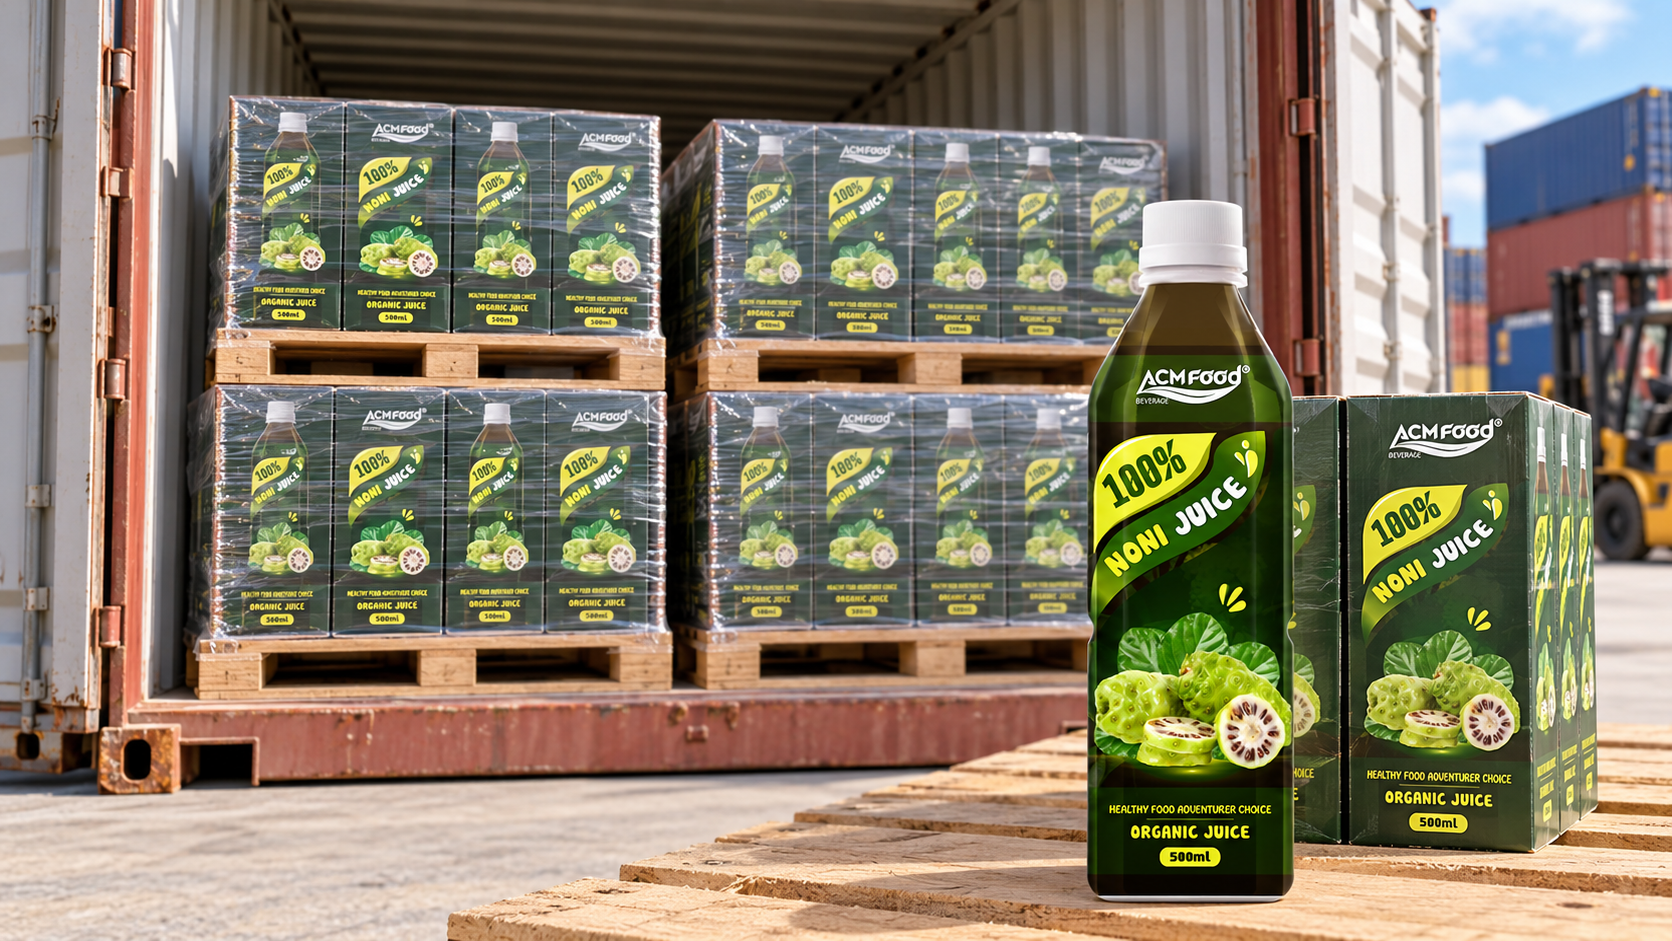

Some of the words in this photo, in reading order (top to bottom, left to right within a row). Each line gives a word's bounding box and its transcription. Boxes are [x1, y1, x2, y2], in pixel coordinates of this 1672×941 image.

[266, 165, 293, 185] 100%
[363, 160, 399, 186] 100%
[571, 168, 604, 193] 100%
[362, 191, 391, 214] NONI
[392, 173, 425, 197] JUICE
[481, 174, 505, 193] 100%
[833, 179, 864, 204] 100%
[570, 200, 597, 220] NONI
[599, 181, 627, 205] JUICE
[750, 185, 772, 205] 100%
[859, 192, 886, 216] JUICE
[261, 298, 293, 306] ORGANIC
[295, 298, 317, 307] JUICE
[366, 301, 401, 309] ORGANIC
[402, 301, 427, 310] JUICE
[608, 306, 628, 315] JUICE
[255, 460, 282, 482] 100%
[353, 449, 390, 478] 100%
[472, 461, 497, 481] 100%
[564, 451, 598, 478] 100%
[743, 462, 768, 482] 100%
[830, 451, 862, 478] 100%
[857, 464, 886, 490] JUICE
[1102, 439, 1187, 509] 100%
[353, 484, 383, 508] NONI
[384, 463, 416, 490] JUICE
[564, 484, 592, 508] NONI
[593, 464, 623, 491] JUICE
[1104, 524, 1169, 578] NONI
[1175, 476, 1247, 535] JUICE
[1371, 490, 1441, 547] 100%
[1371, 559, 1427, 604] NONI
[1432, 519, 1493, 569] JUICE
[284, 602, 305, 611] JUICE
[357, 601, 393, 610] ORGANIC
[394, 601, 418, 610] JUICE
[501, 599, 521, 608] JUICE
[603, 598, 625, 607] JUICE
[1366, 770, 1402, 780] HEALTHY
[1404, 771, 1425, 781] FOOD
[1483, 774, 1511, 784] CHOICE
[1385, 790, 1446, 805] ORGANIC
[1451, 793, 1493, 808] JUICE
[1109, 805, 1149, 814] HEALTHY
[1151, 805, 1175, 814] FOOD
[1238, 805, 1272, 814] CHOICE
[1130, 825, 1198, 839] ORGANIC
[1204, 825, 1250, 839] JUICE
[1419, 817, 1458, 828] 500ml
[1169, 851, 1211, 862] 500ml
